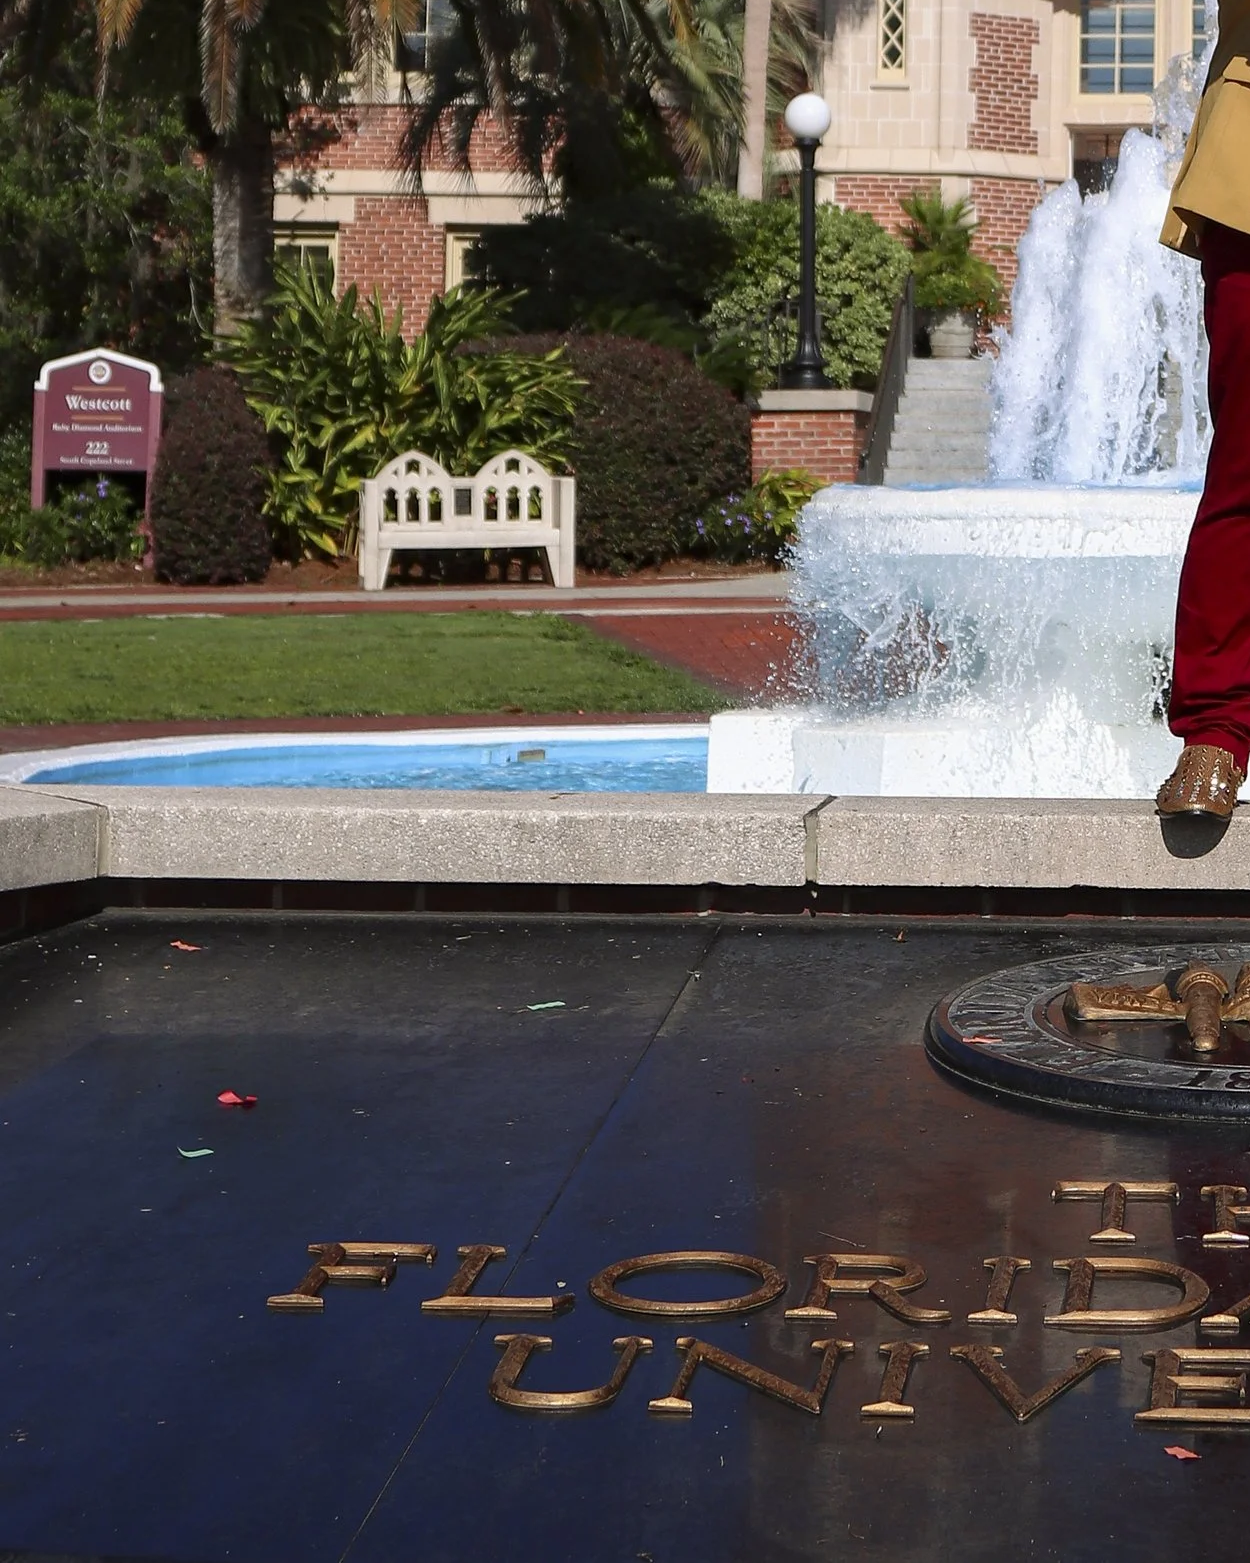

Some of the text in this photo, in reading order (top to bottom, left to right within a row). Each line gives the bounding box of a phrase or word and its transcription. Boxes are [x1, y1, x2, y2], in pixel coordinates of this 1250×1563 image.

[64, 394, 132, 411] Westcott
[71, 423, 102, 433] Diamond
[104, 424, 142, 434] Auditorium
[85, 441, 109, 455] 222
